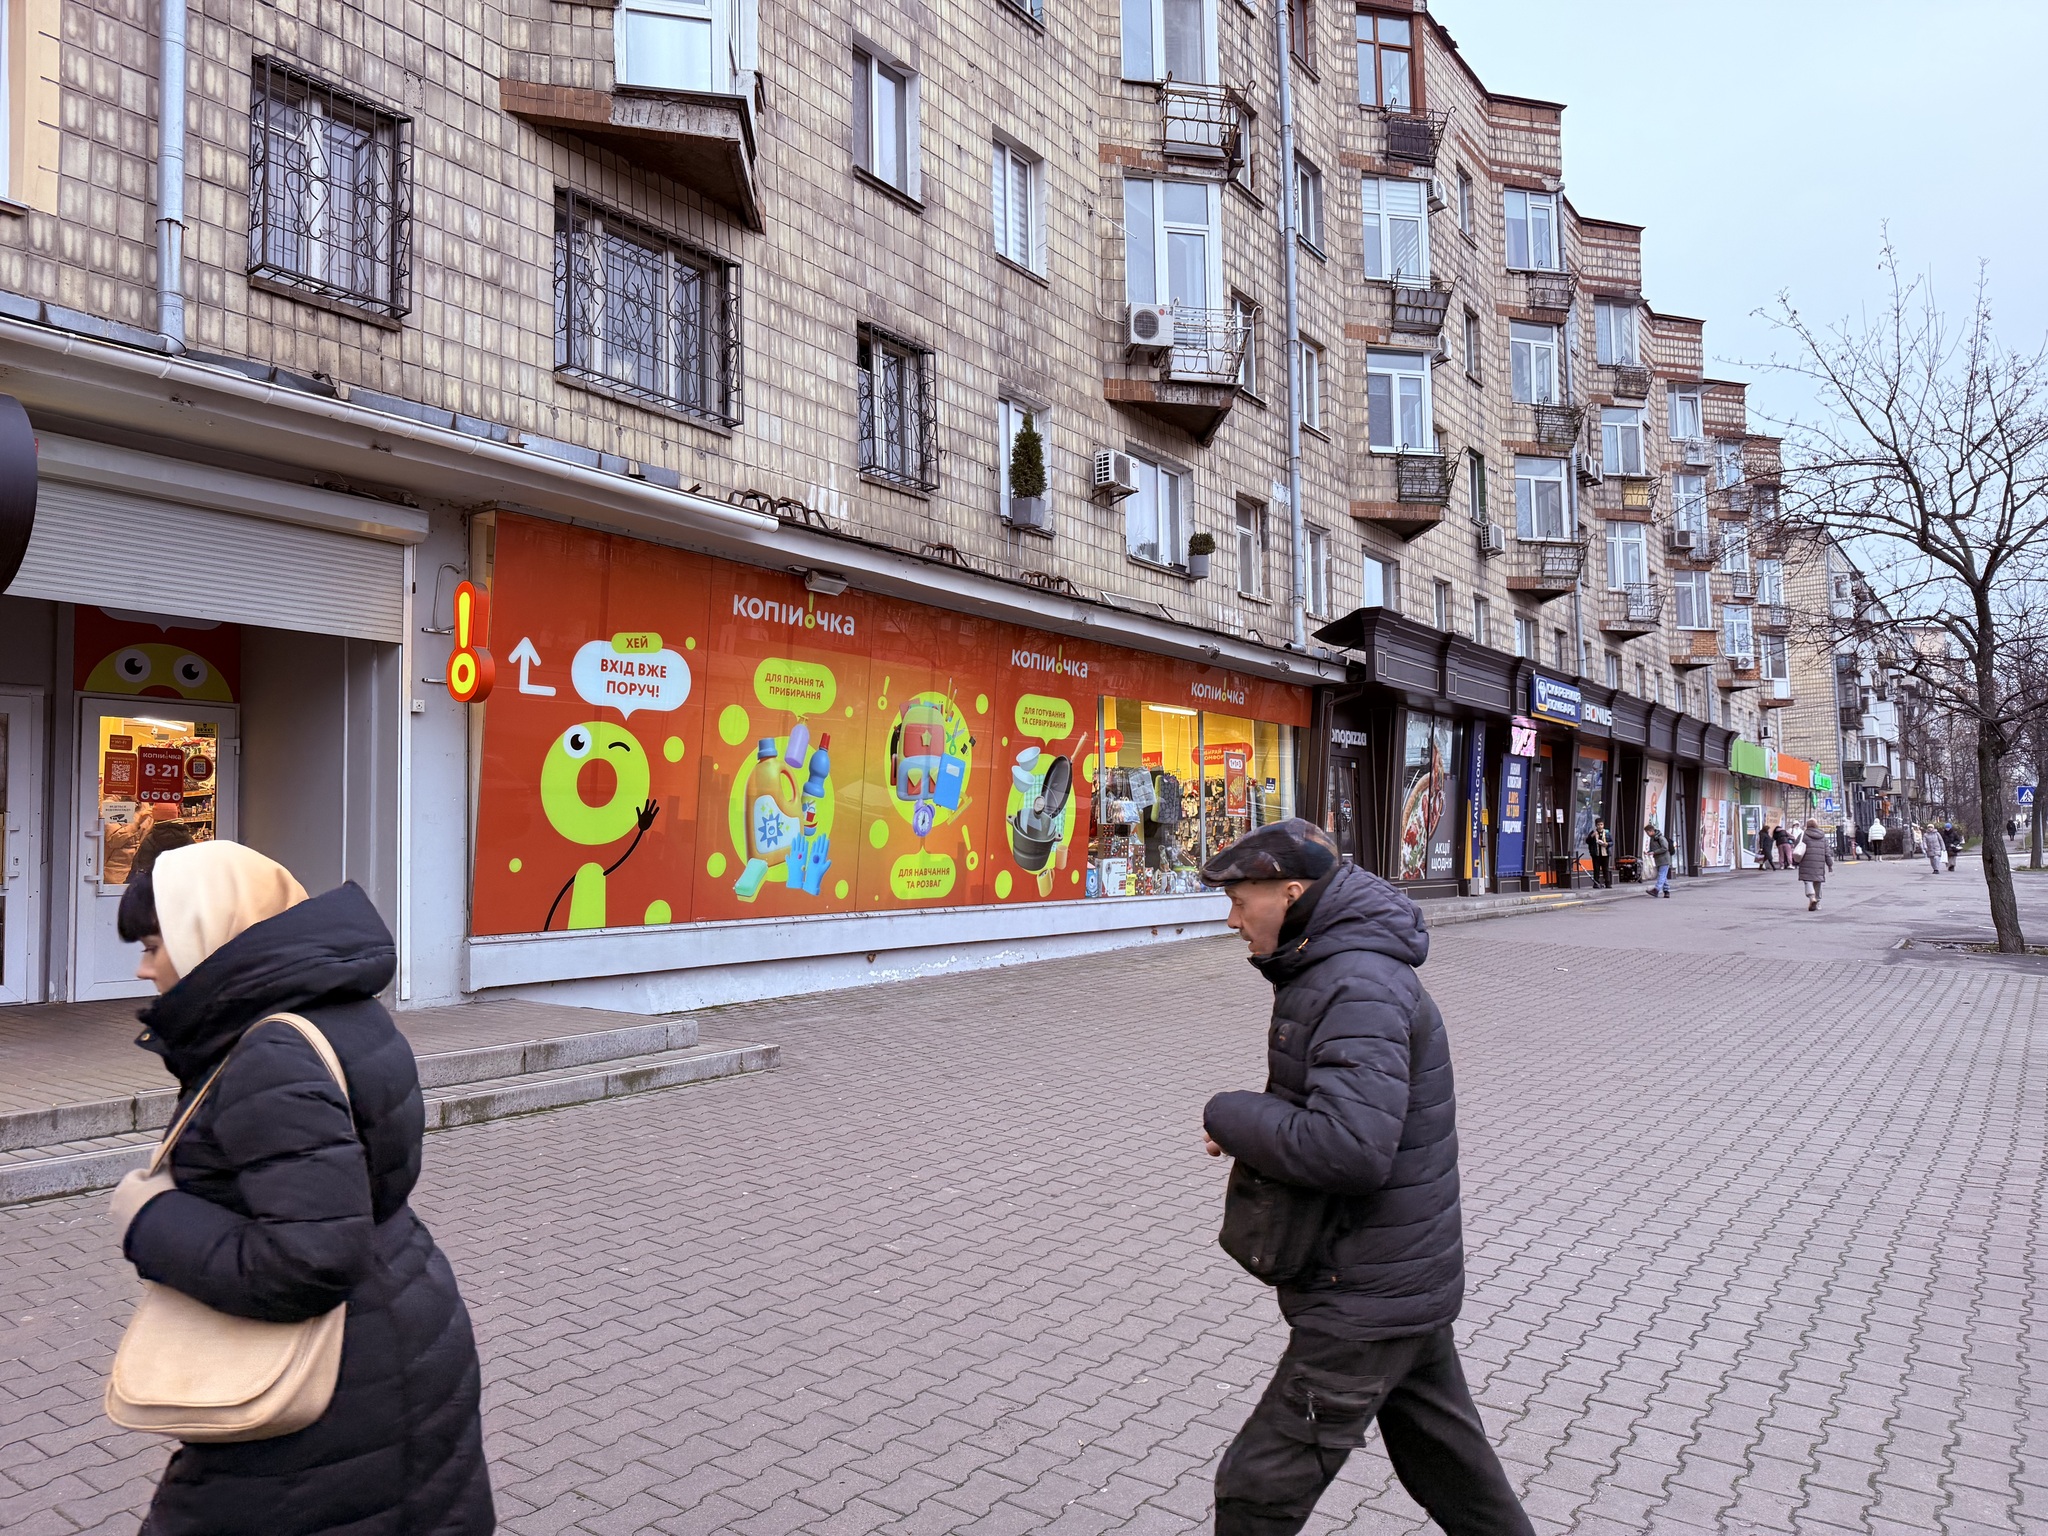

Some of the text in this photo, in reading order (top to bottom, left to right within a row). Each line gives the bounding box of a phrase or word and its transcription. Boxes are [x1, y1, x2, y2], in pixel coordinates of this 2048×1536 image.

[626, 636, 648, 648] ХЕЙ
[600, 658, 667, 678] ВХІД ВЖЕ
[765, 673, 825, 688] ДЛЯ ПРАННЯ ТА
[606, 680, 660, 698] ПОРУЧ!
[769, 686, 821, 700] ПРИБИРАННЯ
[1023, 707, 1066, 719] ДЛЯ ГОТУВАННЯ
[1585, 704, 1612, 726] BONUS
[1022, 717, 1067, 729] ТА СЕРВІРУВАННЯ
[1472, 733, 1483, 838] SKARB.COM.UA
[1434, 839, 1451, 856] АКЦІЇ
[1431, 857, 1453, 872] ЩОДНЯ
[898, 867, 950, 878] ДЛЯ НАВЧАННЯ
[907, 880, 941, 889] ТА РОЗВАГ
